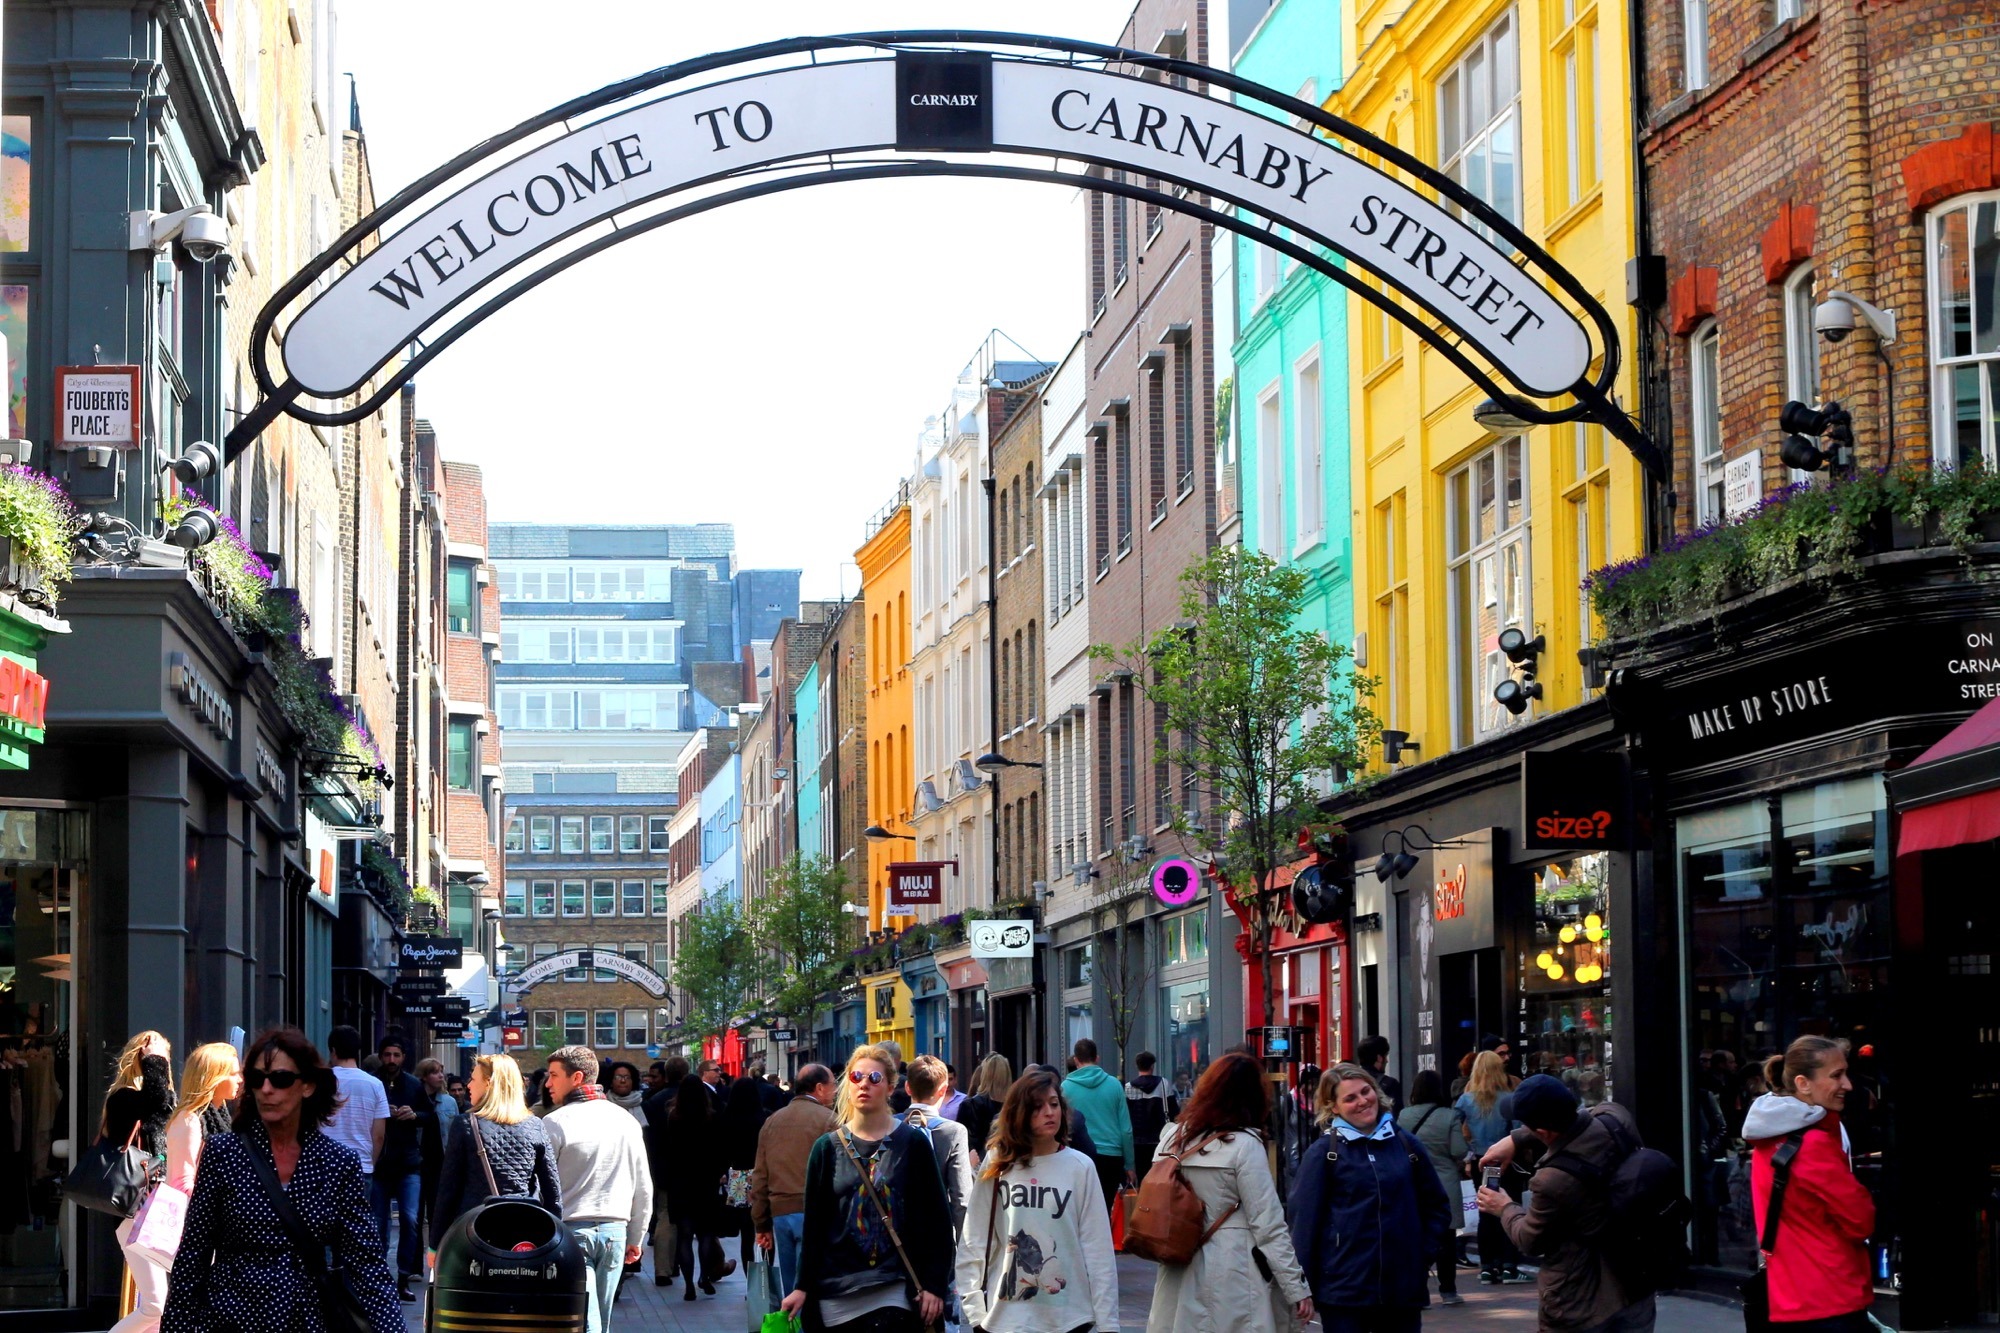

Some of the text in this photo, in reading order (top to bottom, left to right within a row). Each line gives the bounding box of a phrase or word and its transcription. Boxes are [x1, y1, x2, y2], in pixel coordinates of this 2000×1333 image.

[910, 94, 978, 107] CARNABY
[369, 100, 773, 311] WELCOME TO
[1051, 89, 1545, 347] CARNABY STREET
[67, 389, 129, 411] FOUBERT'S
[71, 415, 110, 436] PLACE
[1728, 484, 1746, 506] STREET
[1966, 632, 1994, 648] ON
[1688, 676, 1833, 740] MAKE UP STORE
[1536, 810, 1612, 839] size?
[899, 875, 933, 890] MUJI
[1435, 863, 1467, 922] size?
[402, 943, 459, 960] Pepe Jeans
[560, 958, 572, 966] TO
[596, 956, 663, 993] CARNABY STREET
[775, 1032, 792, 1040] VANS
[998, 1178, 1073, 1219] Dairy
[488, 1267, 539, 1277] general litter
